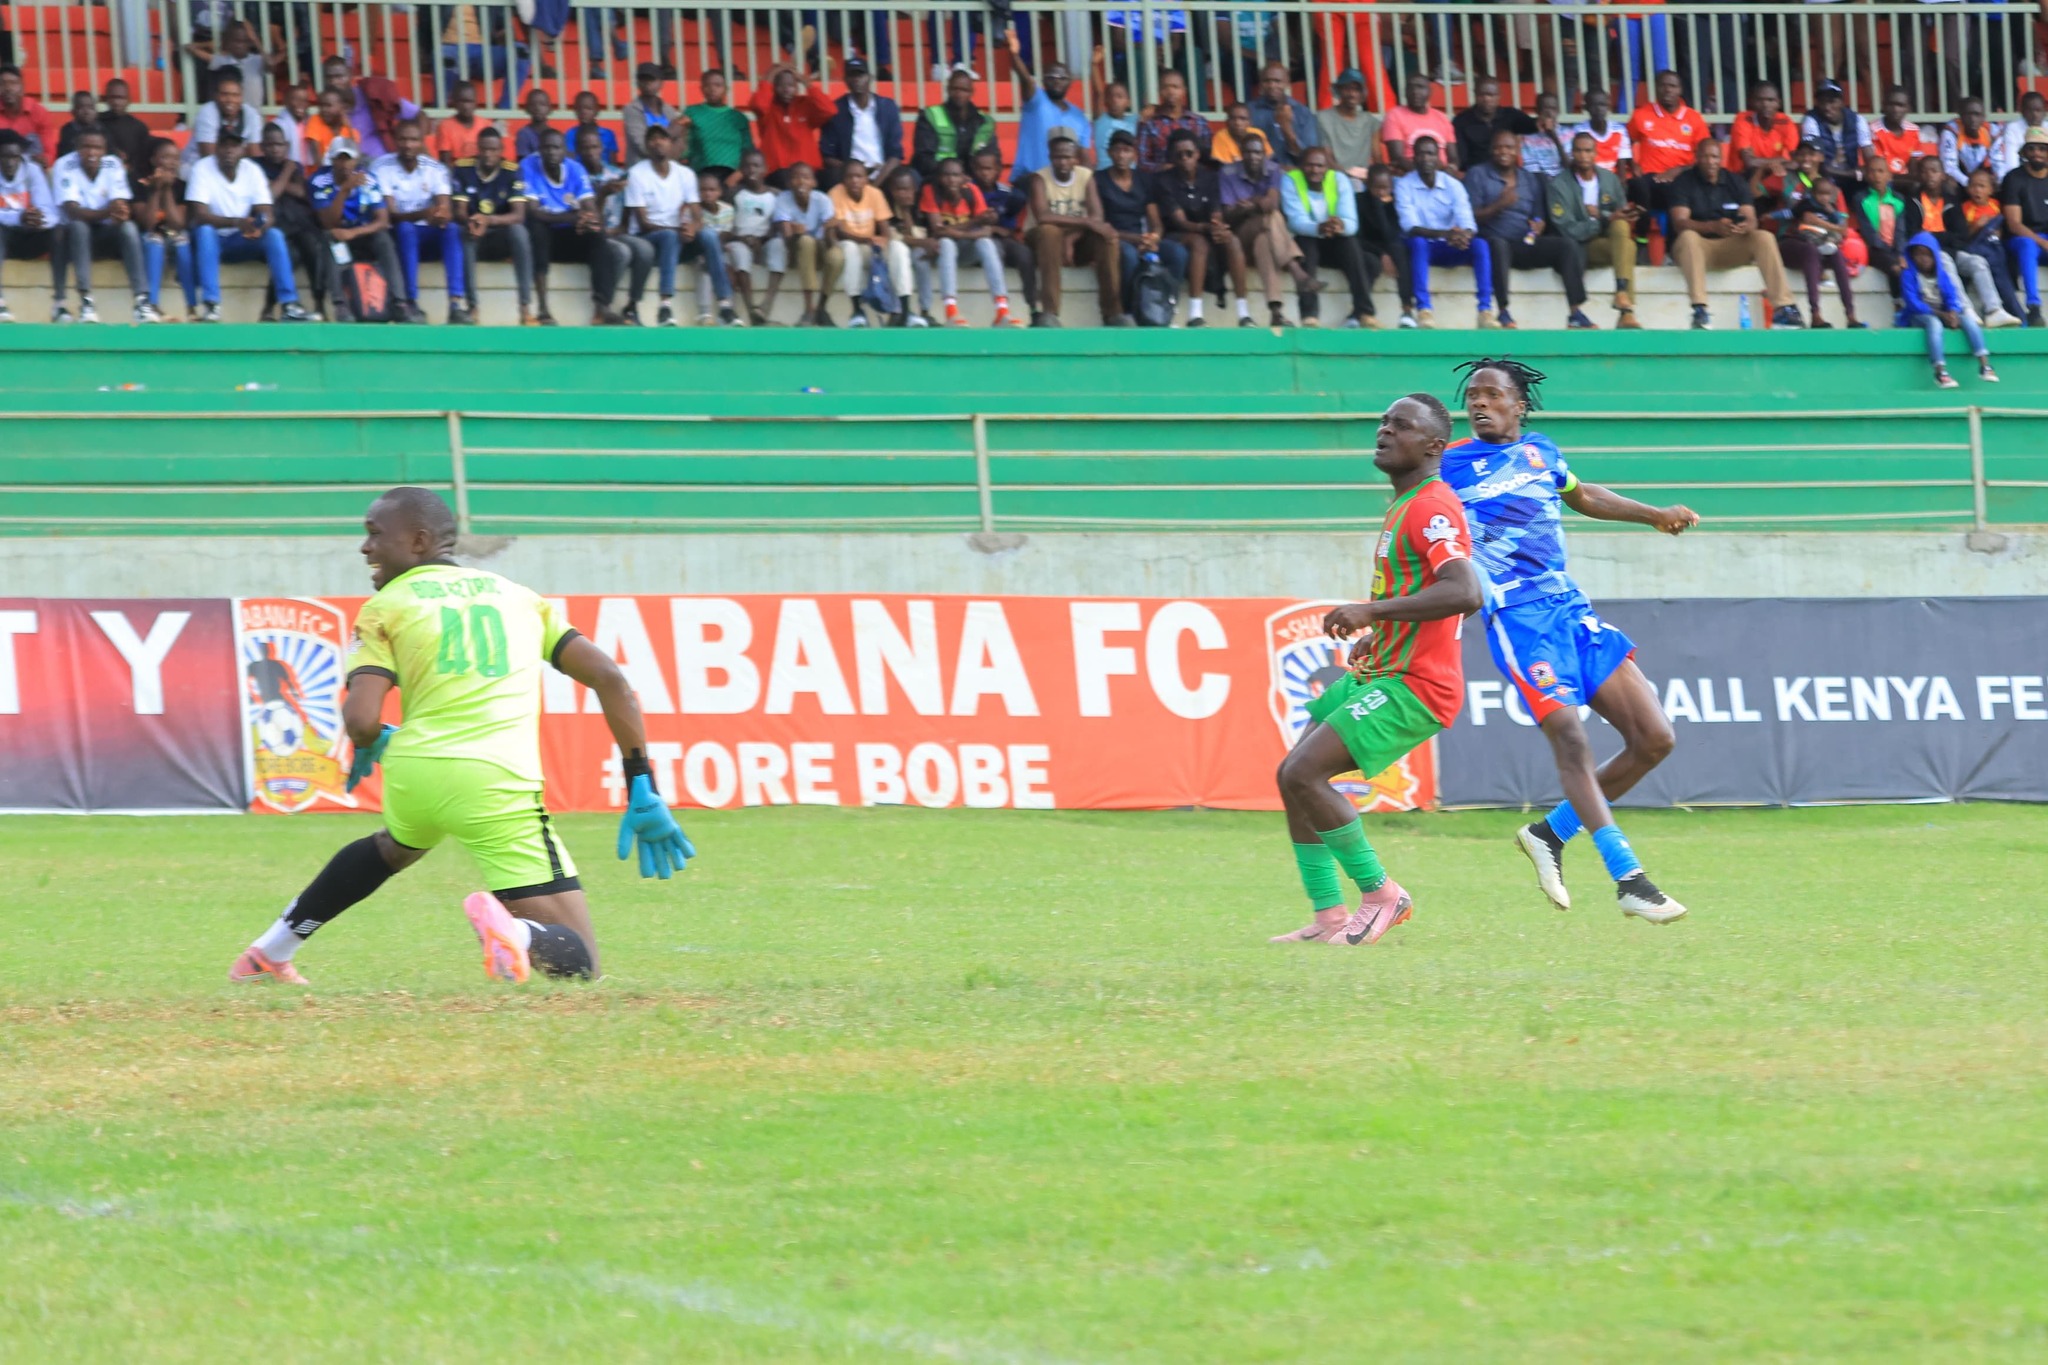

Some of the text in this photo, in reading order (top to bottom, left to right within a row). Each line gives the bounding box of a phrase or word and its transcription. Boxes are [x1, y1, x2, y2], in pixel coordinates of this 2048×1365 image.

[1444, 541, 1465, 557] C
[438, 604, 509, 677] 40
[1069, 600, 1231, 720] FC
[1360, 689, 1388, 710] 20
[1773, 675, 1965, 721] KENYA
[1976, 675, 2048, 720] FE
[855, 742, 1055, 810] BOBE
